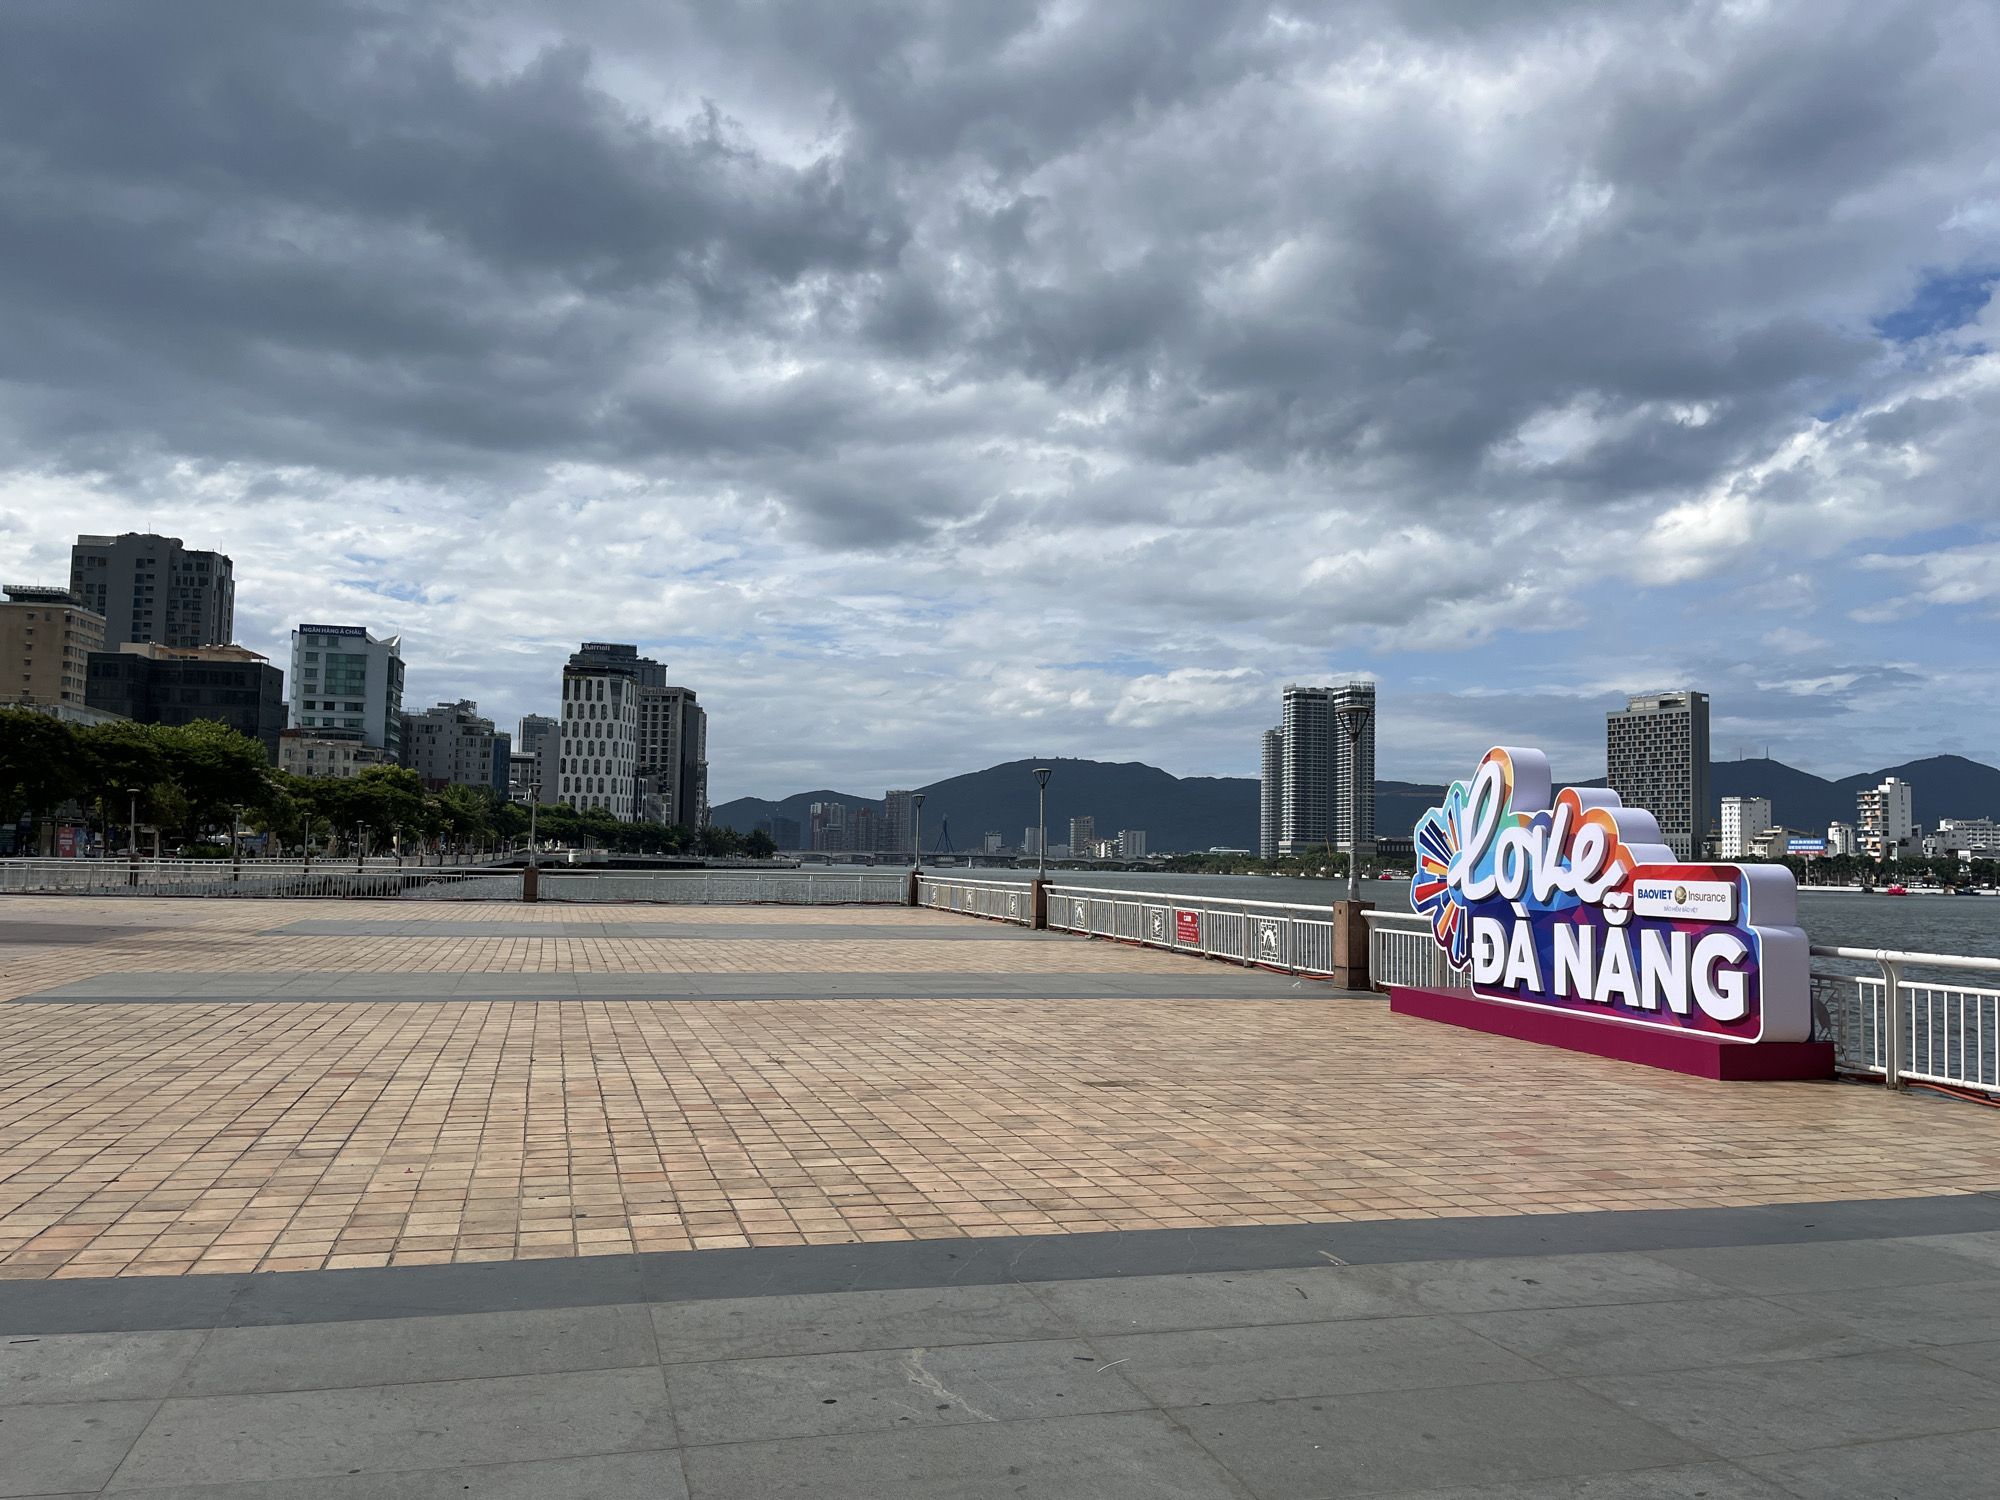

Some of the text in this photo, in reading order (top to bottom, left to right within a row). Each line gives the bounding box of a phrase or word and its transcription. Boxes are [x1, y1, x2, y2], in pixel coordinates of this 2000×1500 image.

[581, 643, 610, 651] Marriott
[1638, 889, 1726, 902] BAOVIET Insurance
[1471, 891, 1750, 1021] ĐÀ NẴNG
